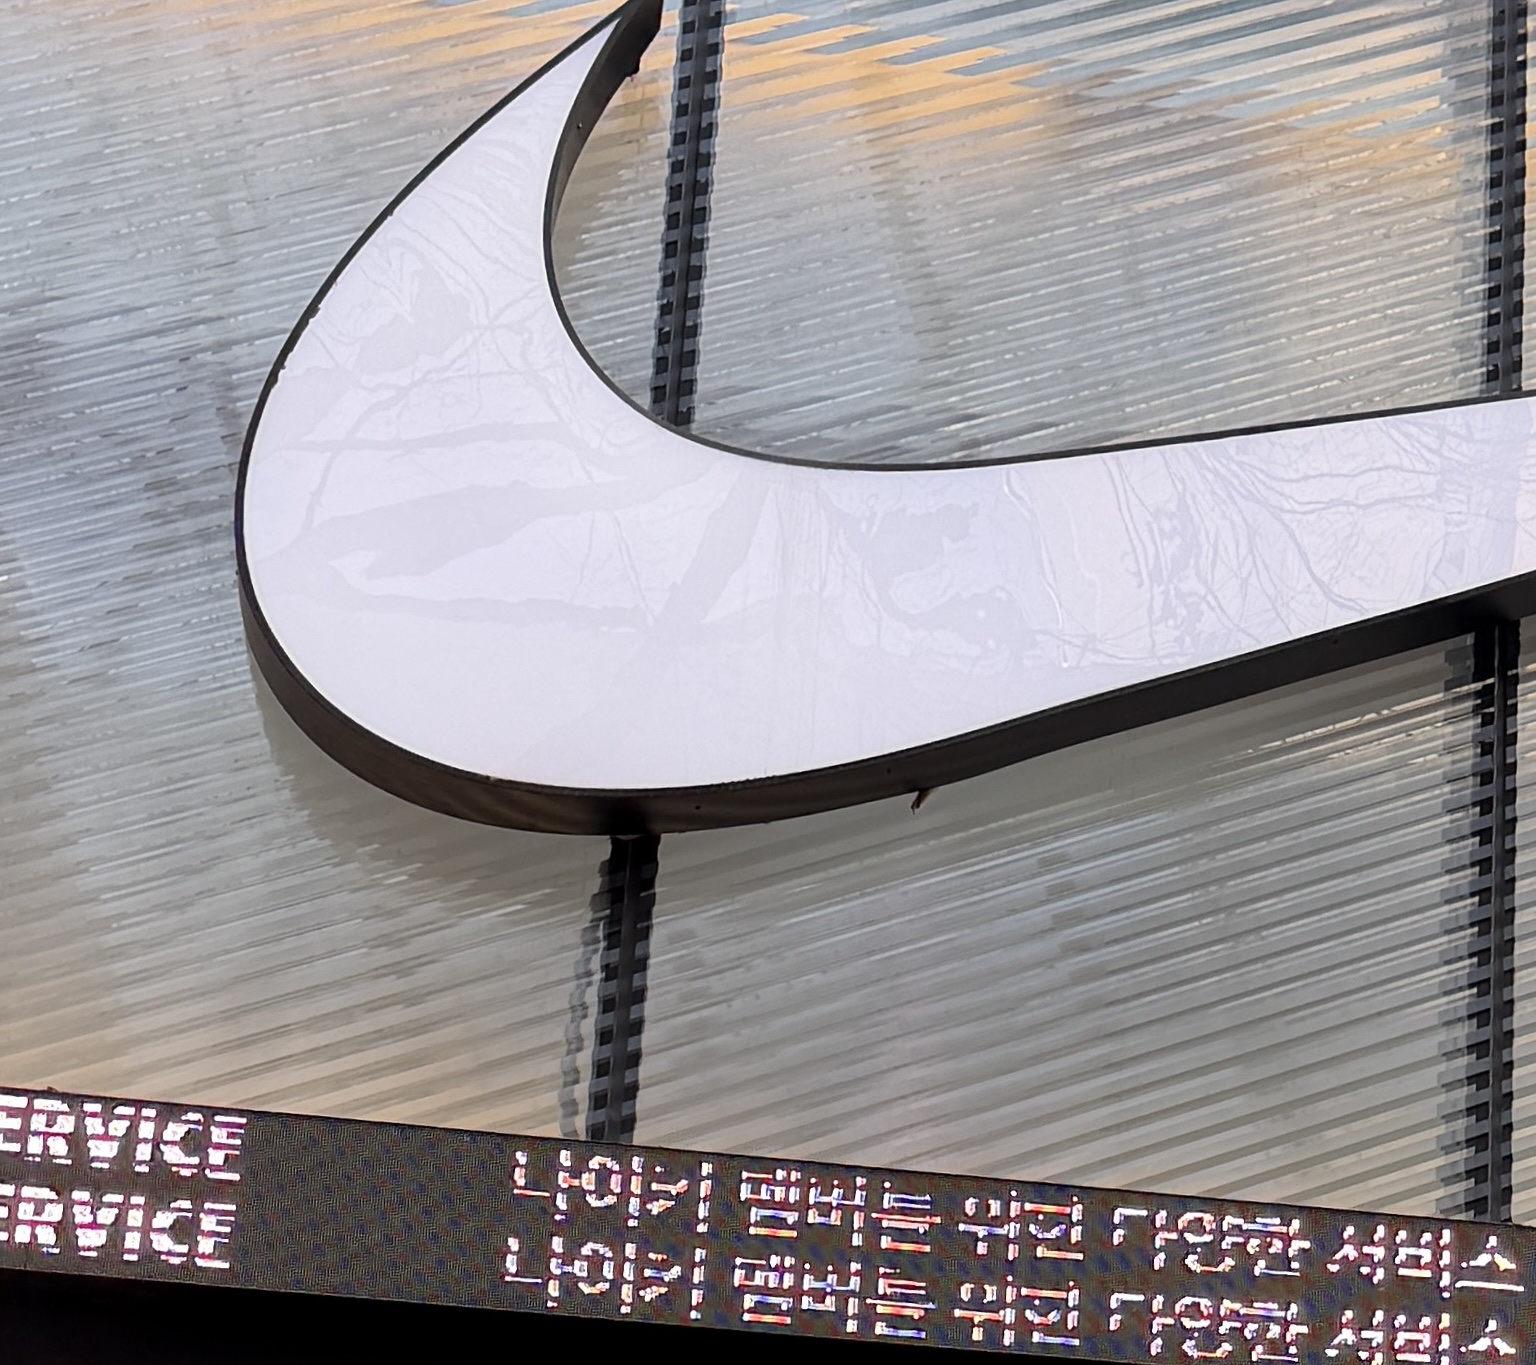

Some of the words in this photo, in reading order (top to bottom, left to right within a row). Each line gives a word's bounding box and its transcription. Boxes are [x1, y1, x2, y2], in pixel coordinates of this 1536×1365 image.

[512, 1149, 713, 1233] 나이키
[958, 1190, 1084, 1262] 위한
[1112, 1206, 1311, 1278] 다양한
[1326, 1223, 1526, 1299] 서비스
[504, 1235, 706, 1320] 나이키
[954, 1273, 1081, 1347] 위한
[1108, 1291, 1310, 1363] 다양한
